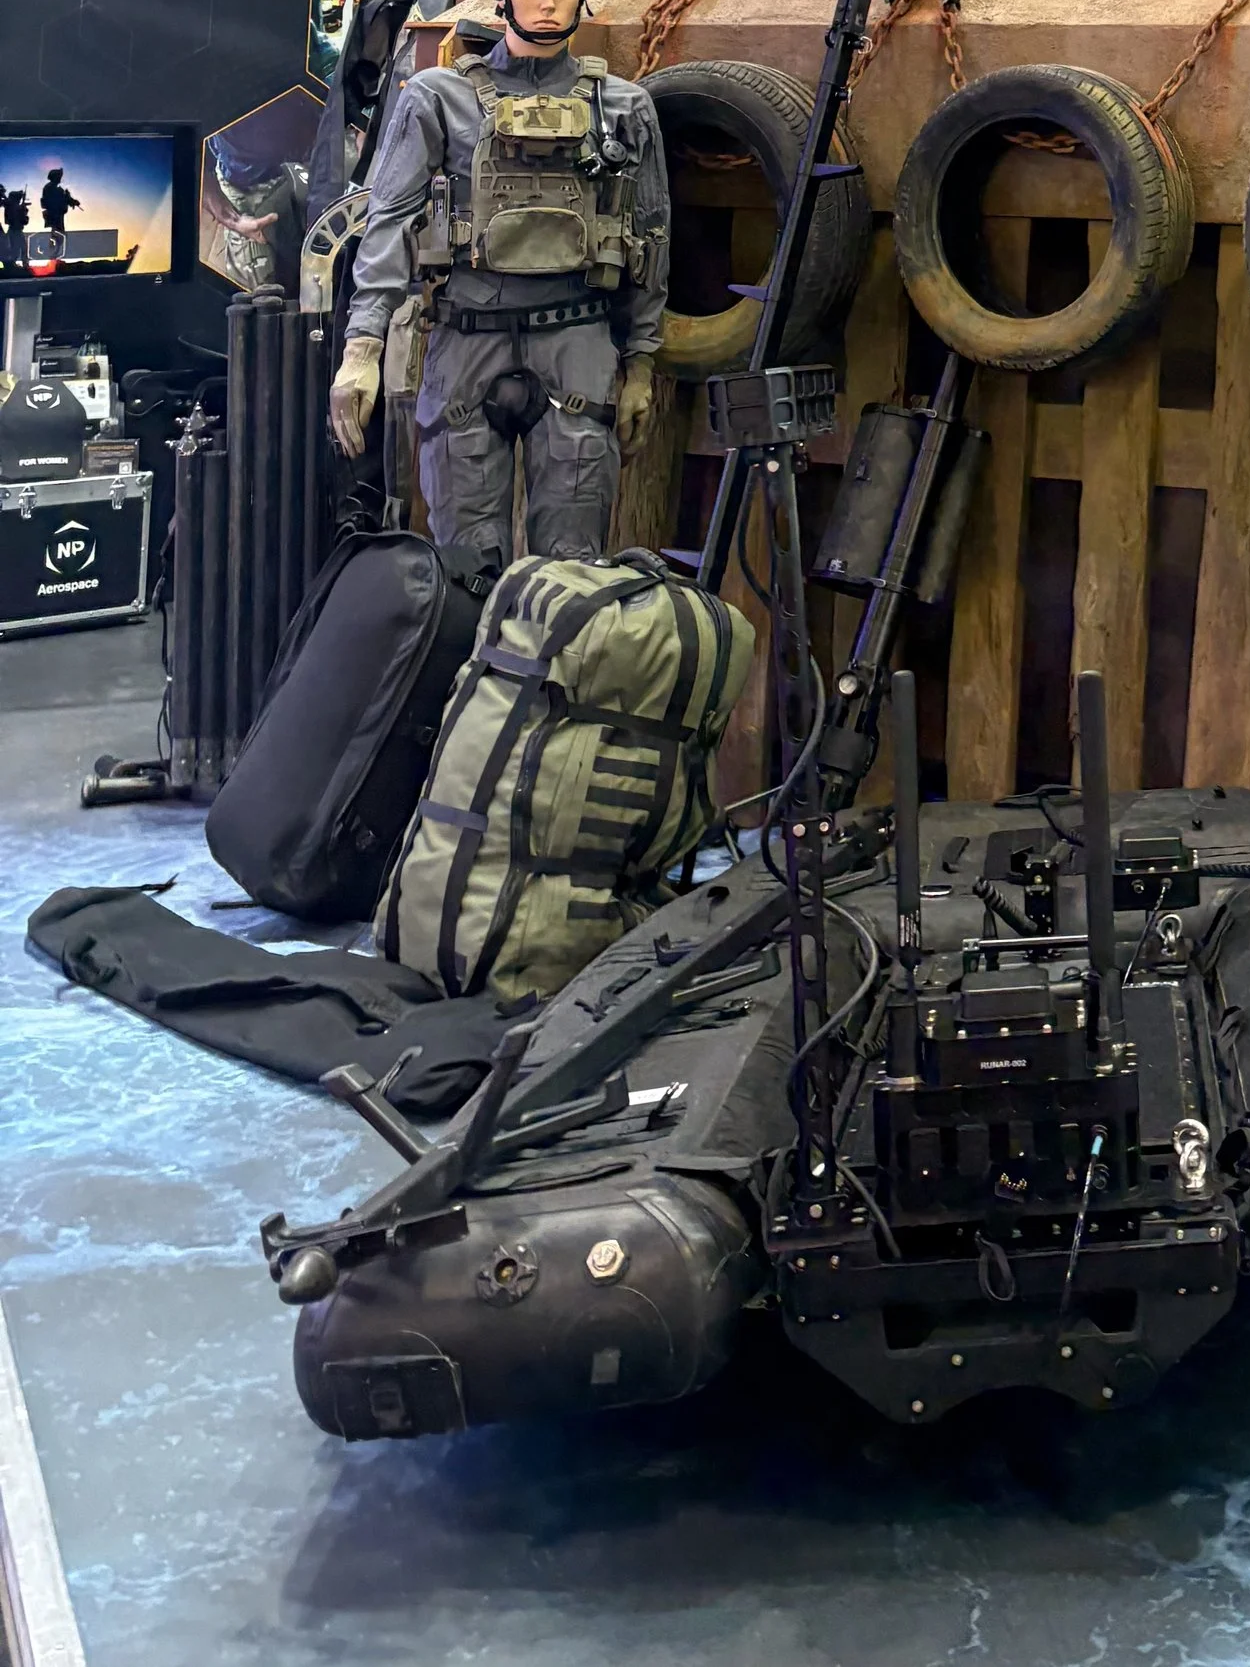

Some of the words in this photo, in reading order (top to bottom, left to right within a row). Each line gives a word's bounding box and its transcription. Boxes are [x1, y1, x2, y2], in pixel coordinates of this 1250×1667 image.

[33, 392, 53, 403] NP
[19, 458, 37, 466] FOR
[37, 457, 69, 465] WOMEN
[57, 540, 86, 559] NP
[37, 579, 99, 596] Aerospace
